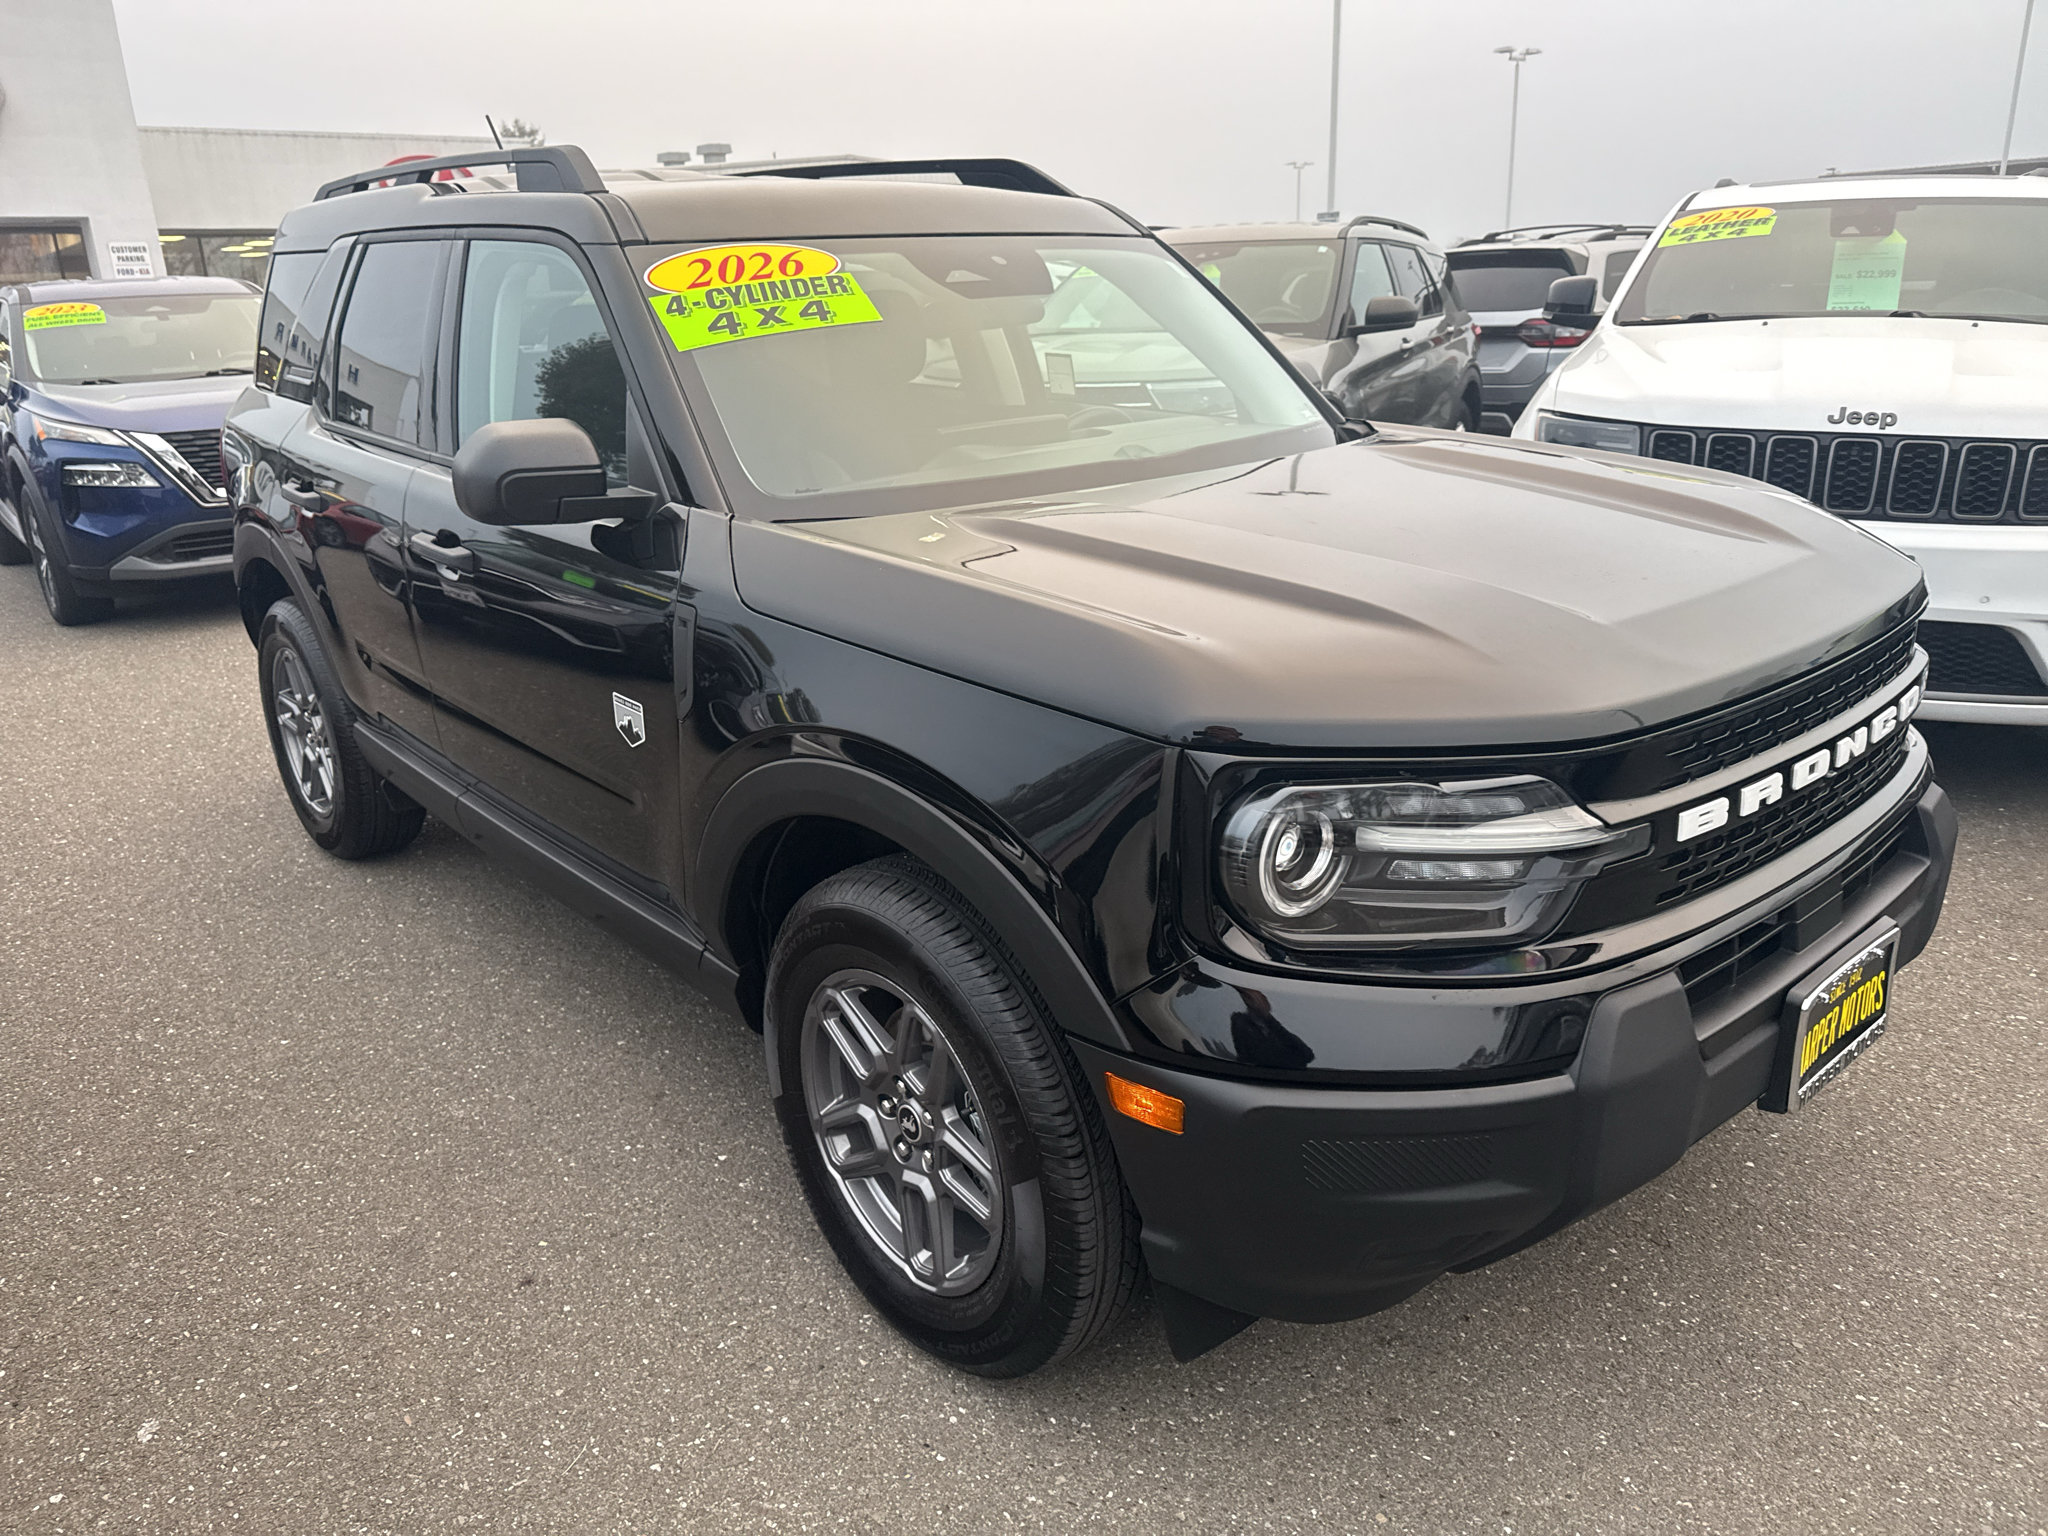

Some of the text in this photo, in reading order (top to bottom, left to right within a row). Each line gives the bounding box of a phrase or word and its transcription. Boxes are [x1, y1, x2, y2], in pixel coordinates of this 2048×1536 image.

[1668, 217, 1773, 237] LEATHER
[1684, 209, 1758, 227] 2020
[1678, 234, 1698, 242] 4
[1727, 228, 1747, 236] 4
[687, 250, 804, 290] 2026
[1856, 269, 1896, 279] $22,999
[666, 275, 855, 317] 4-CYLINDER
[26, 311, 101, 323] FUEL EFFICIENT
[708, 311, 747, 336] 4
[800, 300, 836, 324] 4
[1827, 406, 1897, 430] Jeep
[1677, 685, 1920, 842] BRONCO
[1838, 971, 1886, 1038] MOTORS
